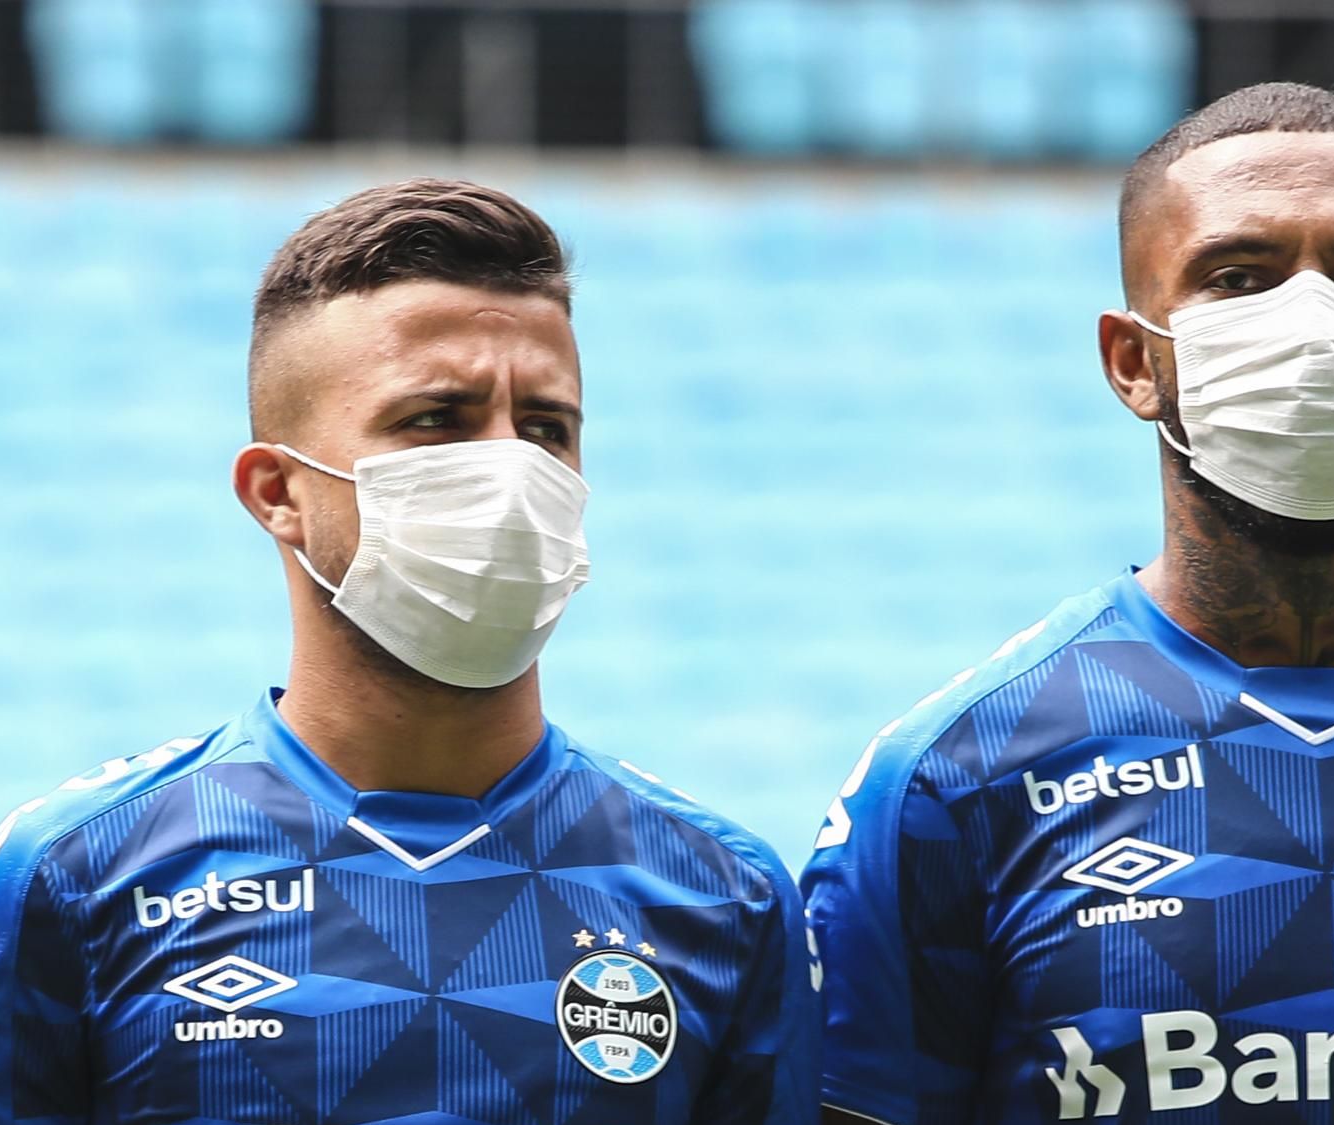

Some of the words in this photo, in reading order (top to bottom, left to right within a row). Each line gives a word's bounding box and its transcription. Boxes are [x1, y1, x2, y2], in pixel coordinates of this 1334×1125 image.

[1022, 744, 1206, 815] betsul
[133, 867, 315, 930] betsul
[1075, 893, 1185, 929] umbro
[603, 978, 631, 992] 1903
[173, 1013, 284, 1043] umbro
[563, 1000, 669, 1038] GRÊMIO
